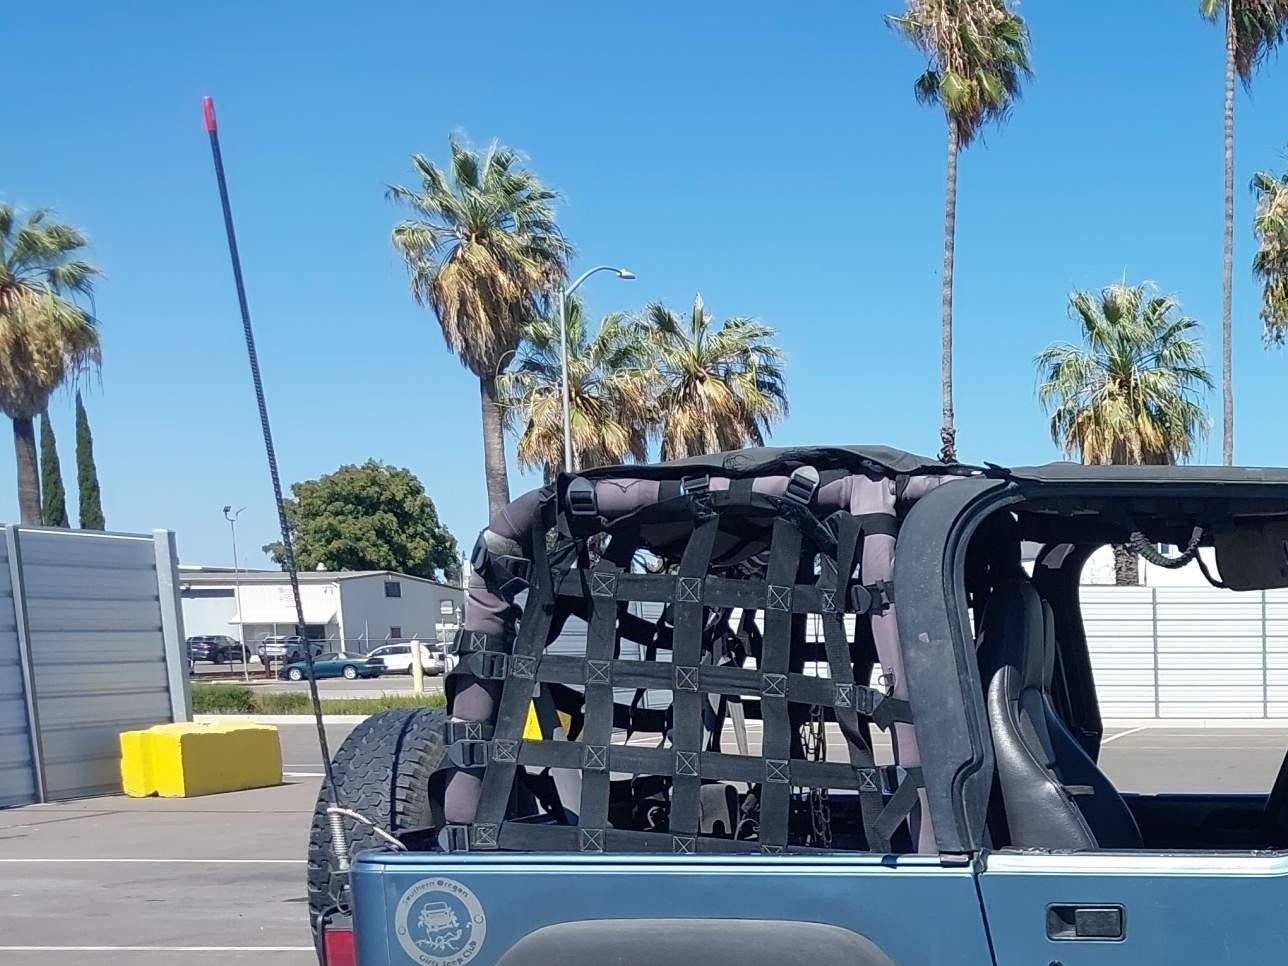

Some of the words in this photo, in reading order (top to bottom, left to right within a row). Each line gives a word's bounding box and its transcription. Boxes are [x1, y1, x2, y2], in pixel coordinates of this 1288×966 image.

[402, 881, 435, 904] Southern
[437, 880, 469, 897] Oregon
[463, 940, 477, 958] Club
